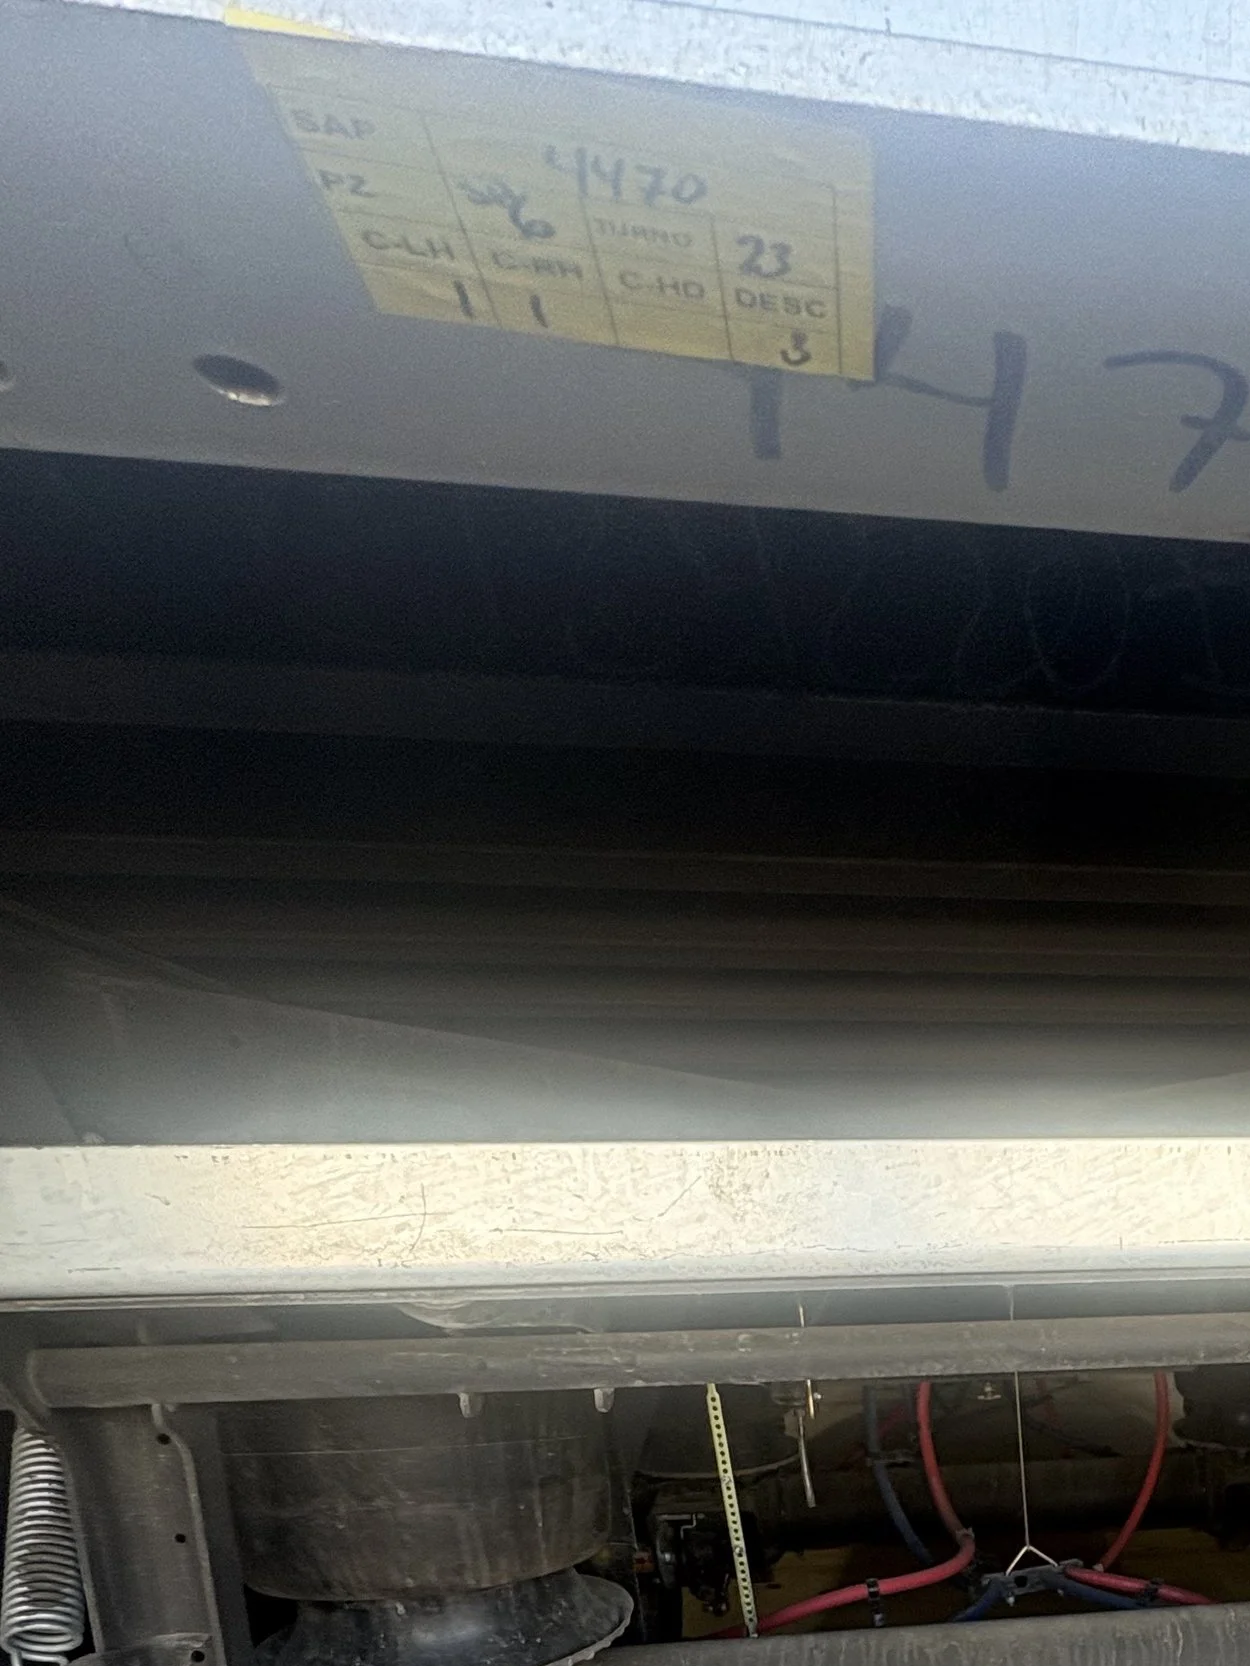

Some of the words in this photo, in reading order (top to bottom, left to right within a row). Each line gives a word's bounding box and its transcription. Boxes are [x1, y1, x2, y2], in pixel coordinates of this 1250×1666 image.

[292, 109, 376, 140] SAP
[317, 168, 377, 198] PZ
[736, 232, 793, 278] 23
[361, 230, 455, 261] C-LH
[734, 285, 828, 319] DESC
